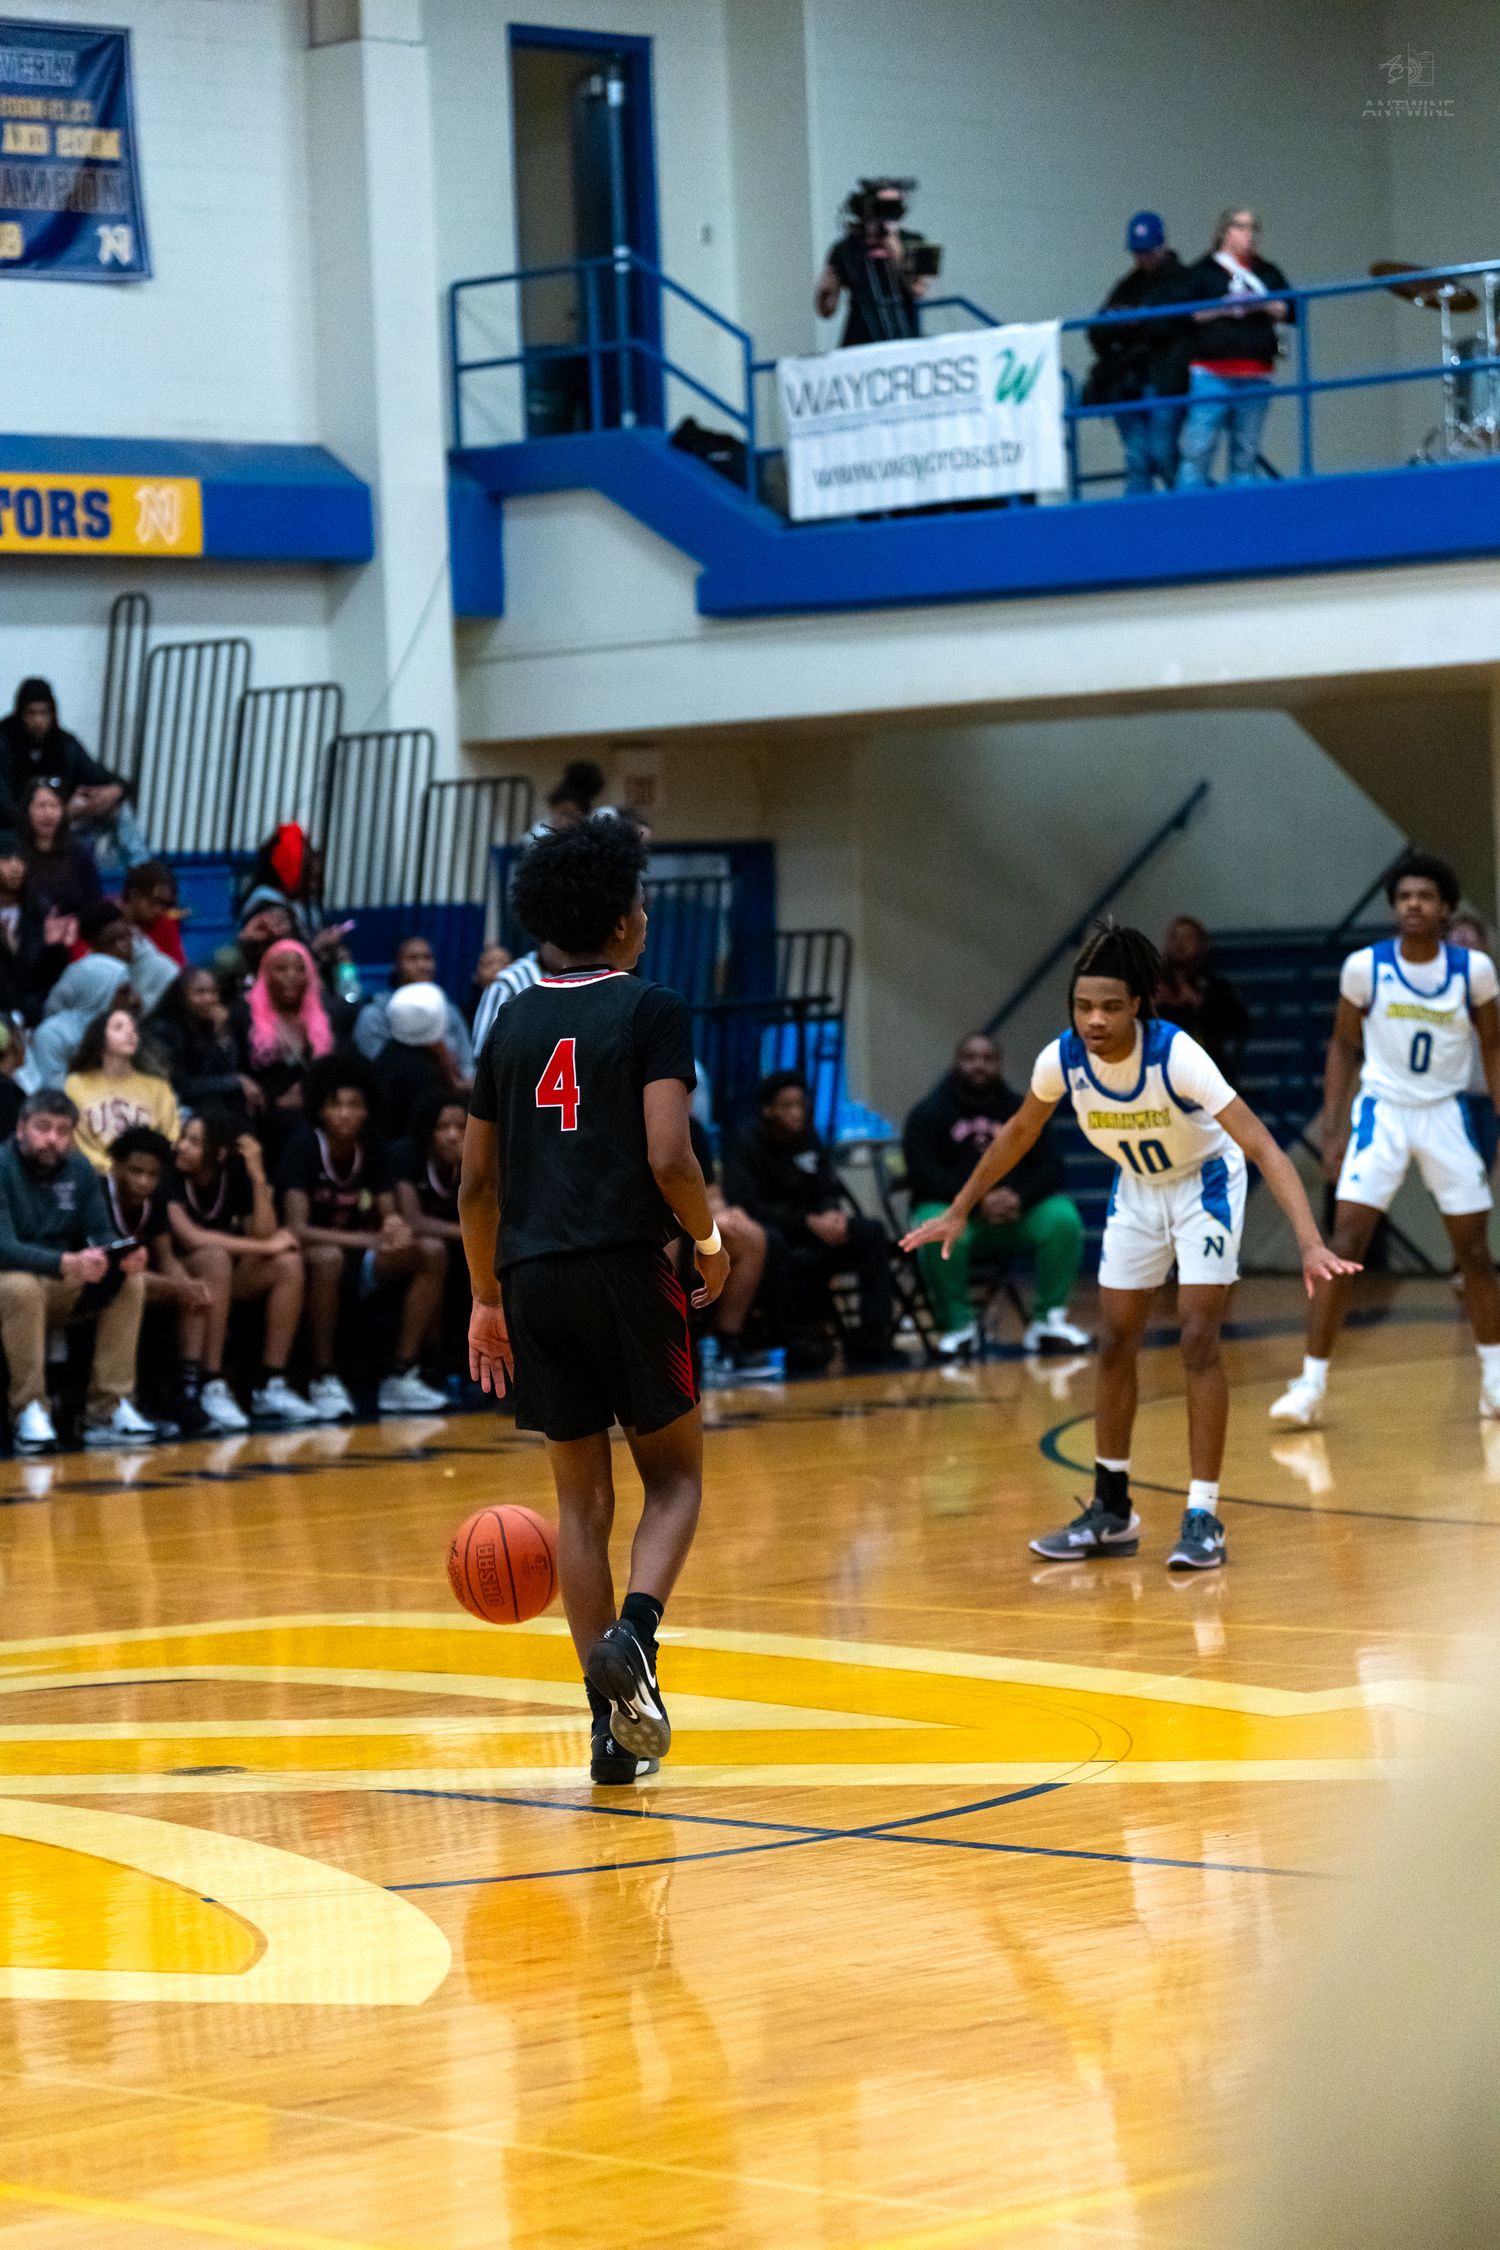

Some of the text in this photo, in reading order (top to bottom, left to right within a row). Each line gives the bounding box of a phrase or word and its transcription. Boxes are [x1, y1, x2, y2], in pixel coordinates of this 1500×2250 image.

[0, 47, 77, 88] VERLY
[786, 356, 978, 416] WAYCROSS
[1410, 1030, 1432, 1073] 0
[535, 1037, 580, 1132] 4
[1117, 1139, 1173, 1176] 10
[1203, 1236, 1225, 1258] N
